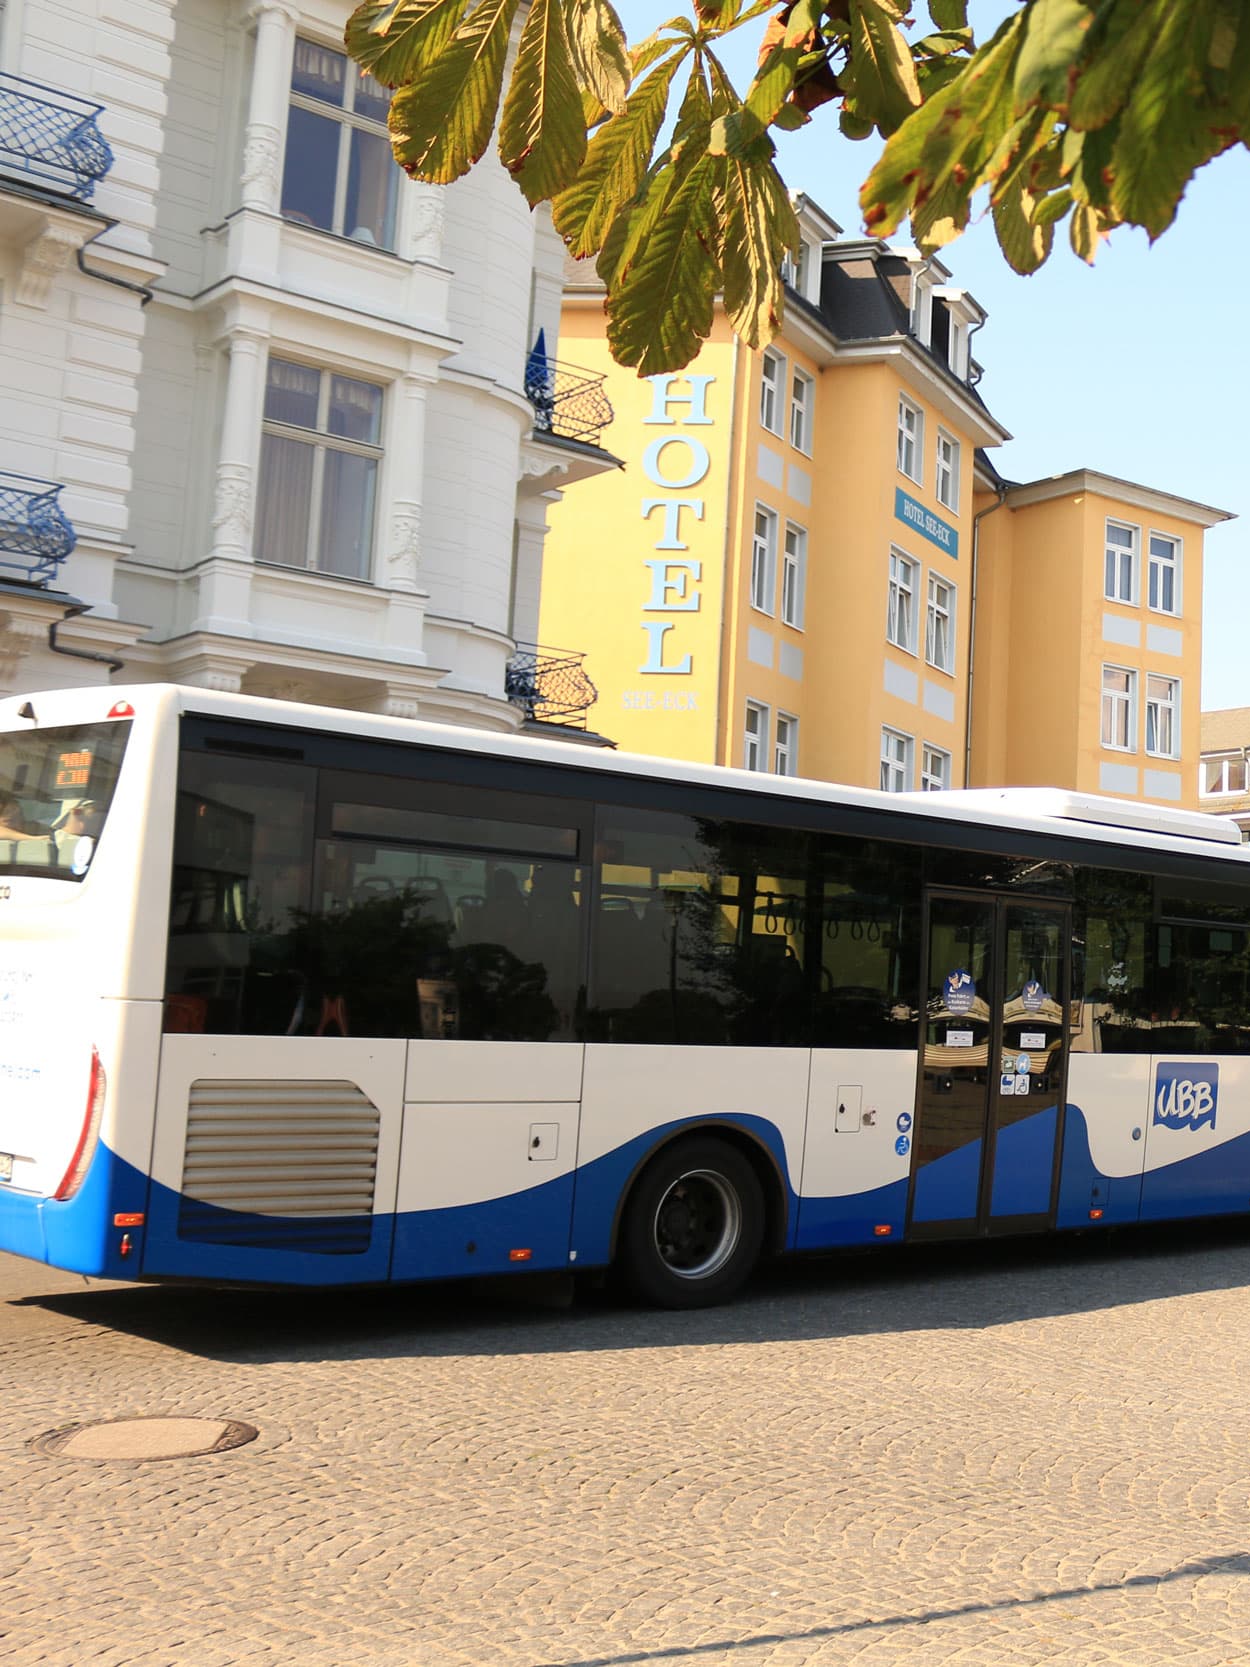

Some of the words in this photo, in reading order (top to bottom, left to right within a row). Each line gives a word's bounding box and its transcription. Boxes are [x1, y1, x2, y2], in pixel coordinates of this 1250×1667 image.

[638, 374, 716, 674] HOTEL
[903, 498, 925, 528] HOTEL
[925, 514, 951, 546] SEE-ECK
[621, 691, 700, 711] SEE-ECK
[1158, 1078, 1214, 1119] UBB
